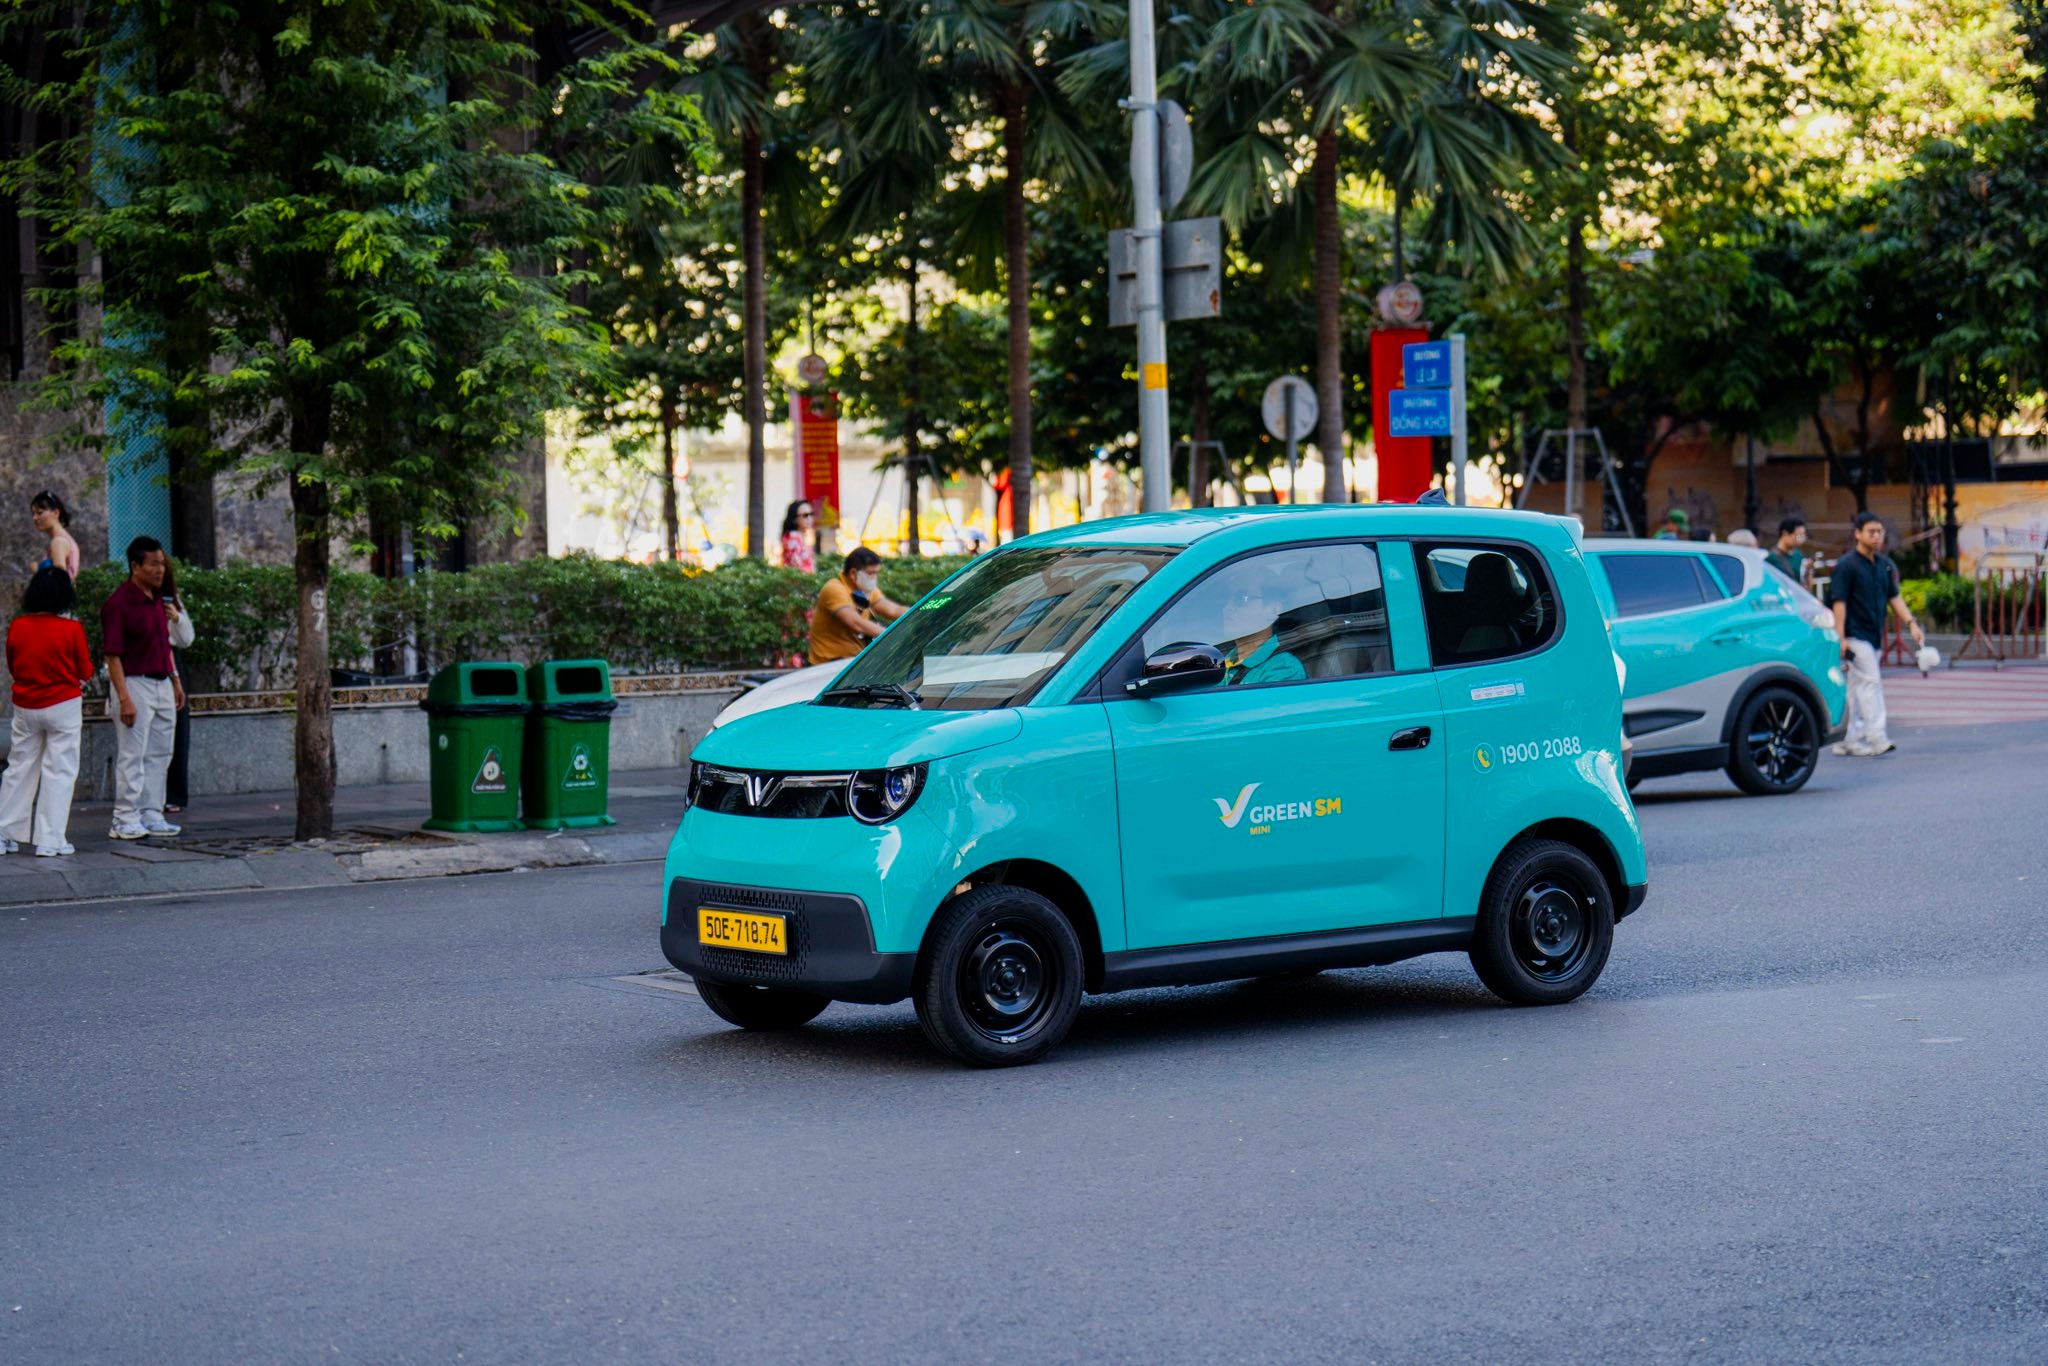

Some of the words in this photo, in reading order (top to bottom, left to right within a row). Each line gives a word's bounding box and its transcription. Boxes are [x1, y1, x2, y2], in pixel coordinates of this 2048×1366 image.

[1500, 741, 1539, 765] 1900
[1543, 736, 1582, 759] 2088
[1249, 801, 1312, 824] GREEN
[1315, 797, 1342, 817] SM
[1249, 825, 1271, 836] MINI
